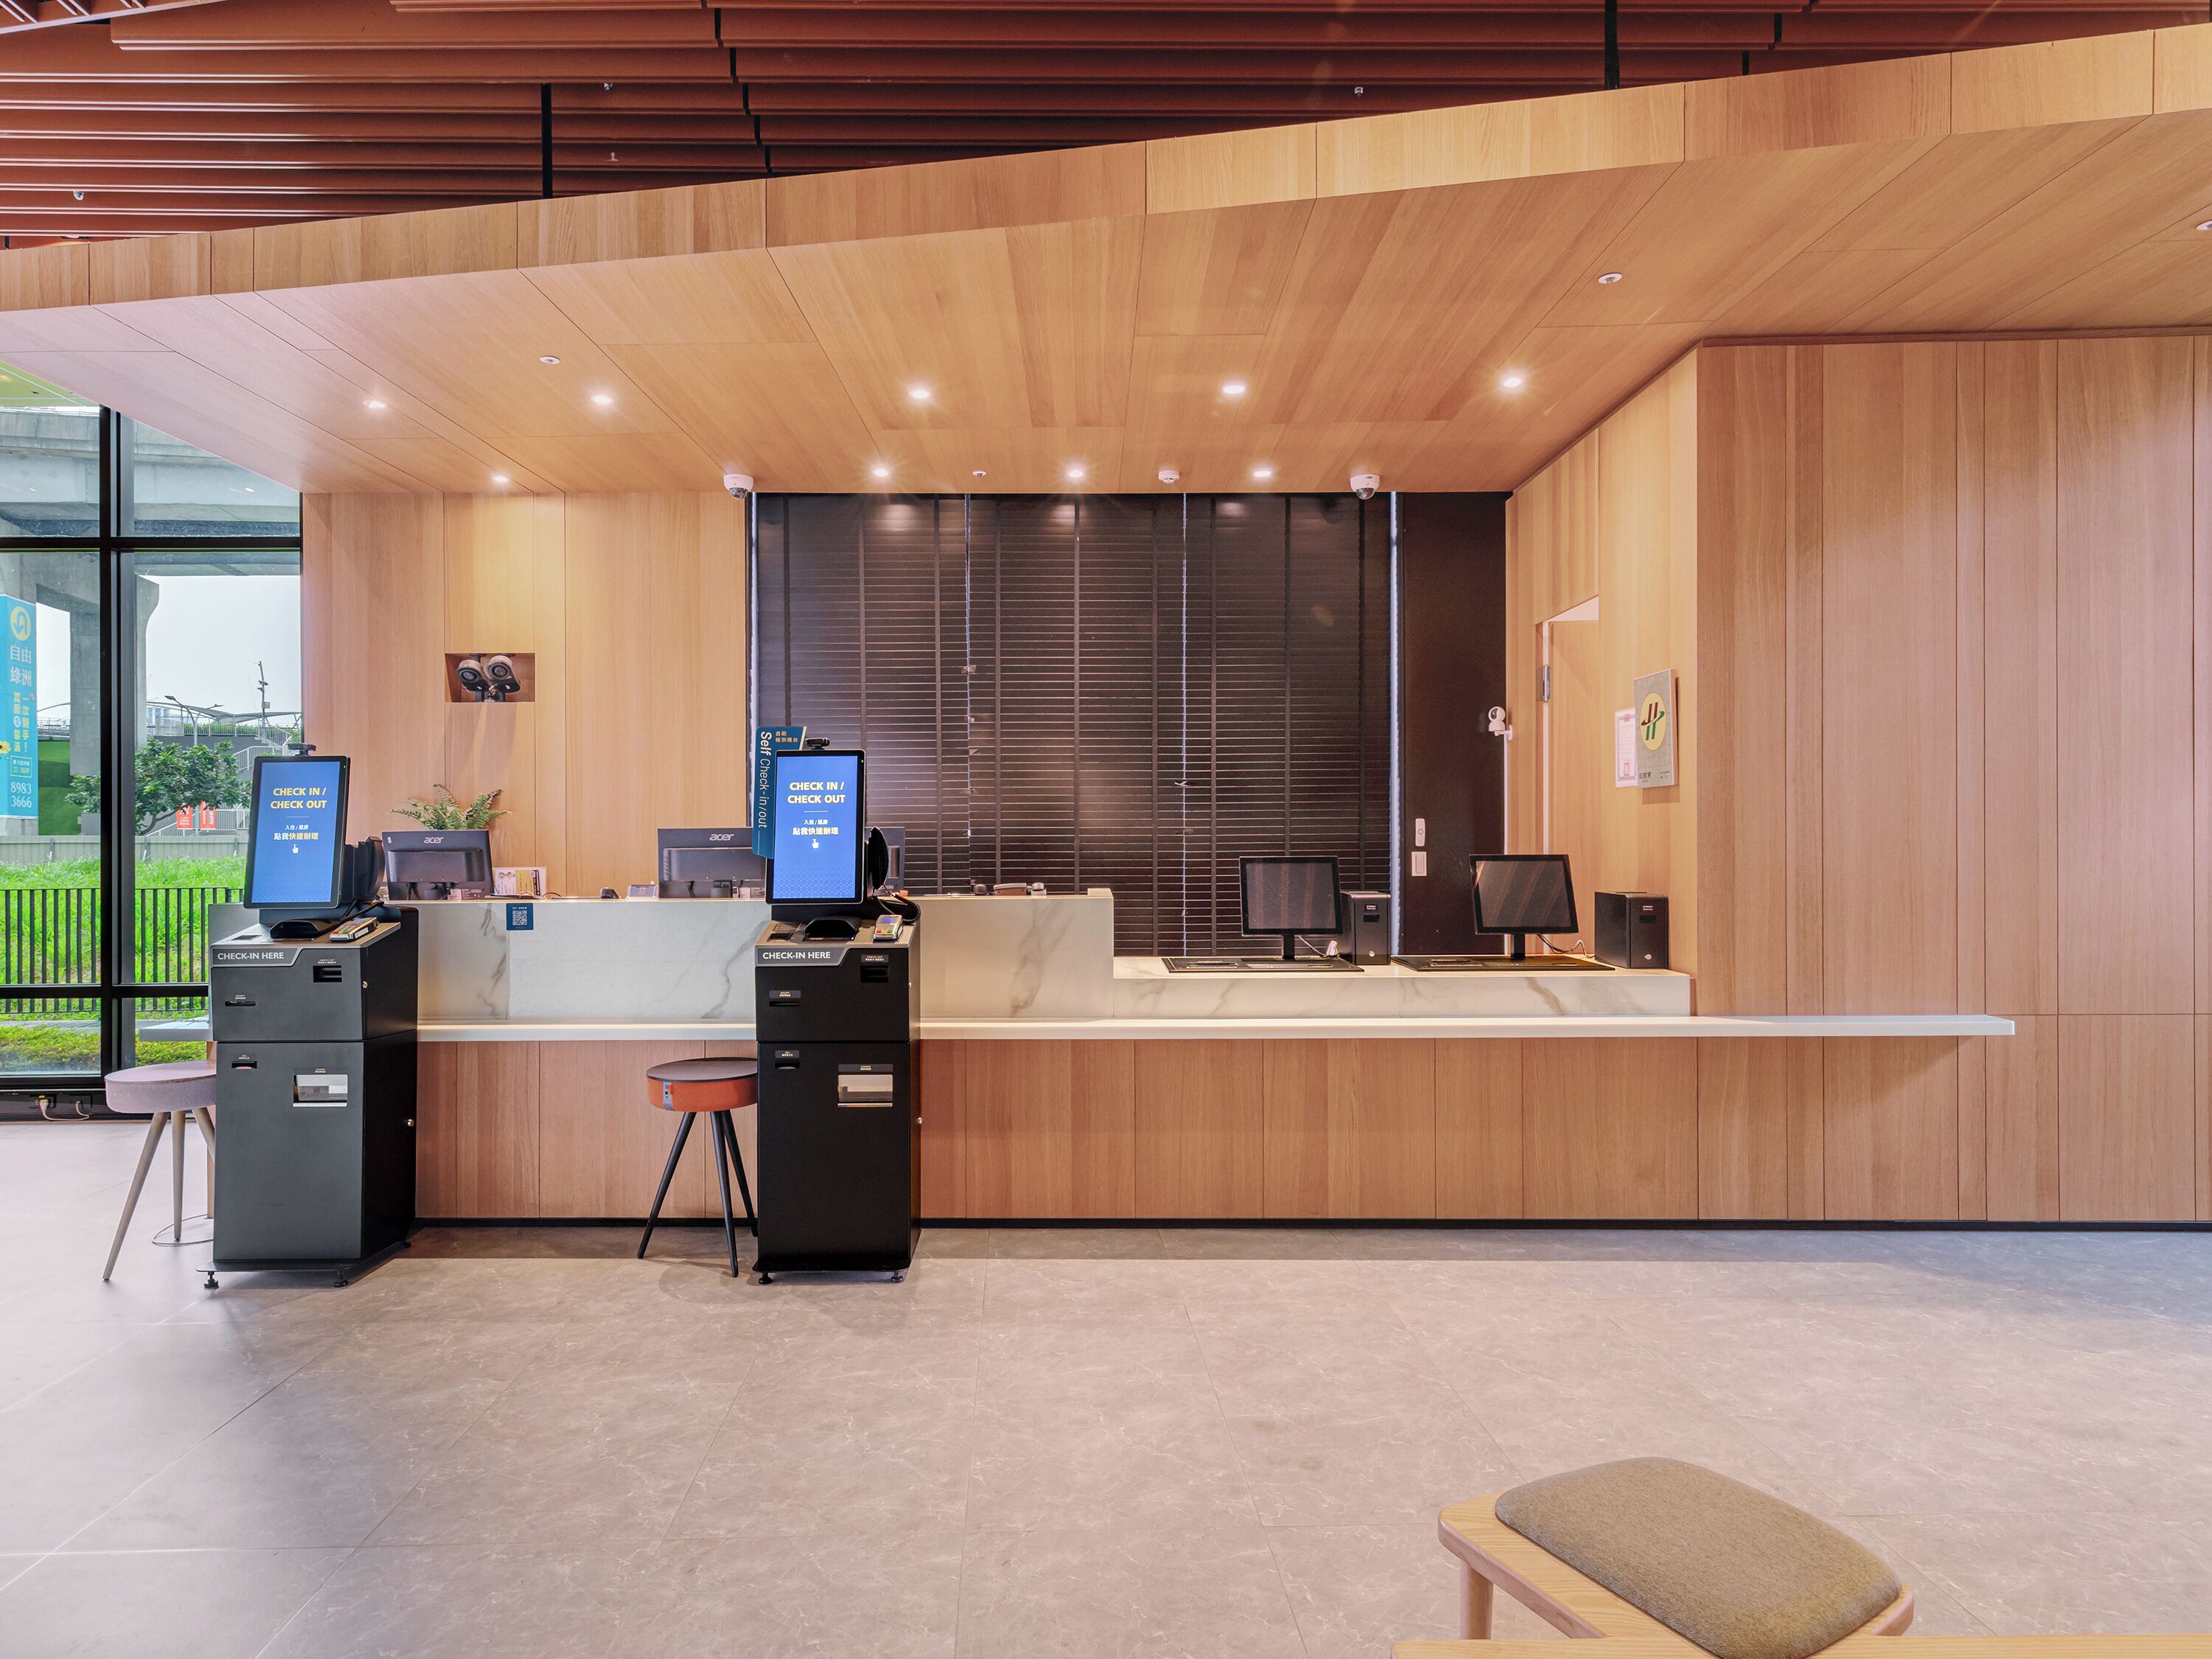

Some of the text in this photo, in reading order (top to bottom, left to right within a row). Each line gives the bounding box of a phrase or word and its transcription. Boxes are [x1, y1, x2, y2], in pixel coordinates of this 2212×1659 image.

[10, 643, 32, 664] 自由
[10, 667, 32, 687] 綠洲
[758, 731, 772, 829] Self Check-in/out
[10, 782, 32, 794] 8983
[789, 782, 824, 790] CHECK
[827, 782, 838, 790] IN
[273, 787, 306, 796] CHECK
[309, 787, 320, 796] IN
[11, 795, 32, 808] 3666
[271, 800, 327, 809] CHECK OUT
[787, 795, 846, 804] CHECK OUT
[218, 952, 260, 960] CHECK-IN
